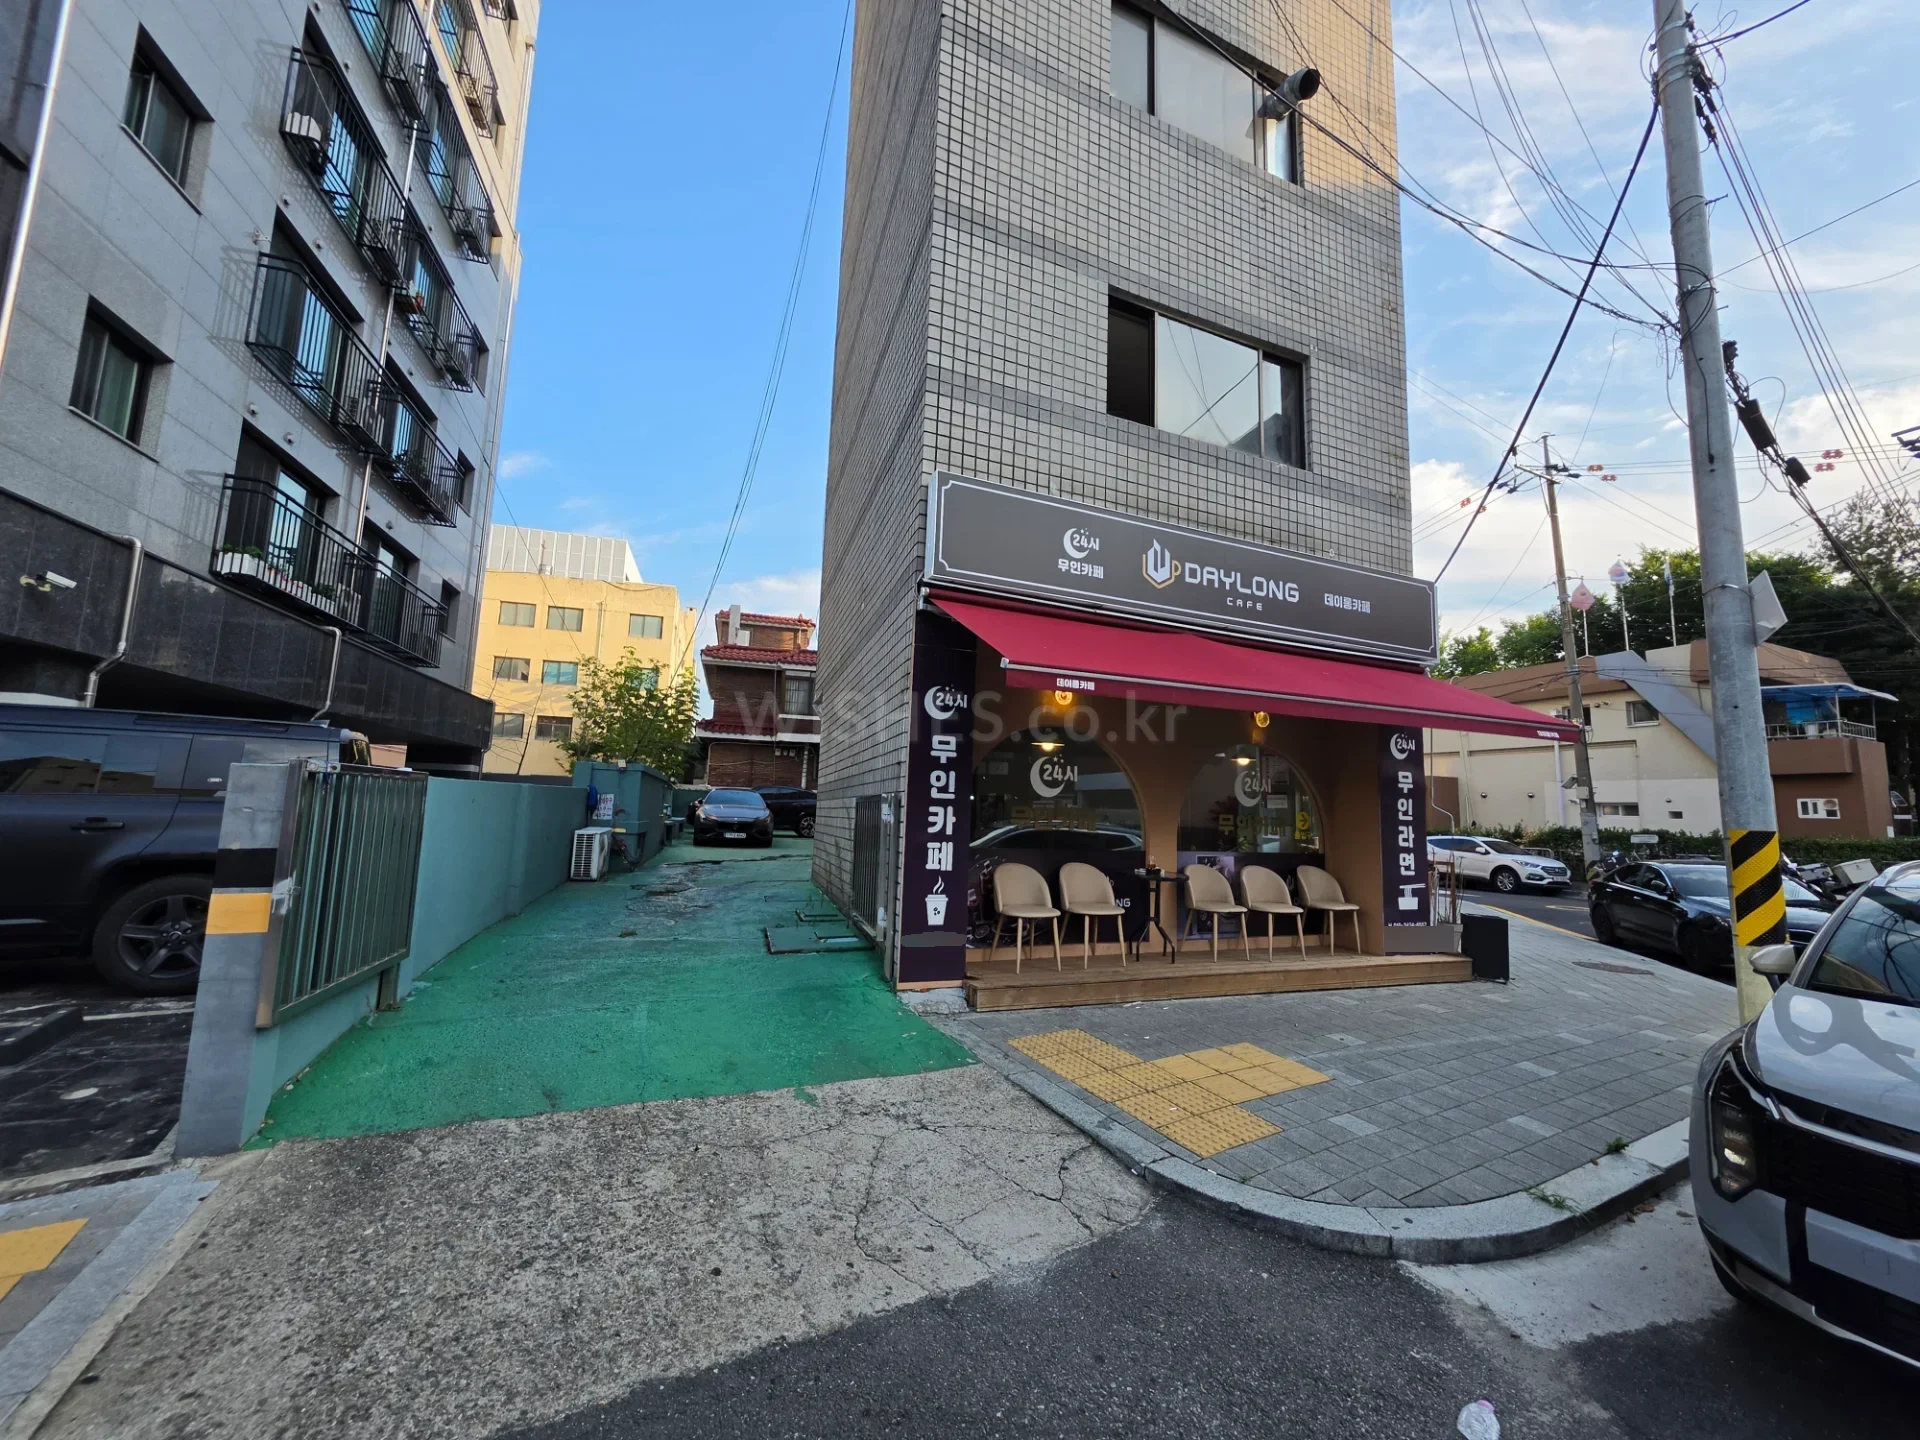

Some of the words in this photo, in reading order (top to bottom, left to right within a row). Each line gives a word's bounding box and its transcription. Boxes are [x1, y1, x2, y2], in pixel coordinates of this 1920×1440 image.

[1072, 533, 1100, 551] 24시
[1057, 558, 1104, 579] 무인카페
[1184, 561, 1300, 603] DAYLONG
[1226, 597, 1264, 611] CAFE
[1324, 592, 1372, 614] 데이롱카페
[935, 691, 968, 709] 24시
[1396, 738, 1416, 751] 24시
[1042, 763, 1079, 783] 24시
[1244, 777, 1272, 793] 24시
[925, 734, 958, 872] 무인카페
[1397, 771, 1415, 876] 무인라면
